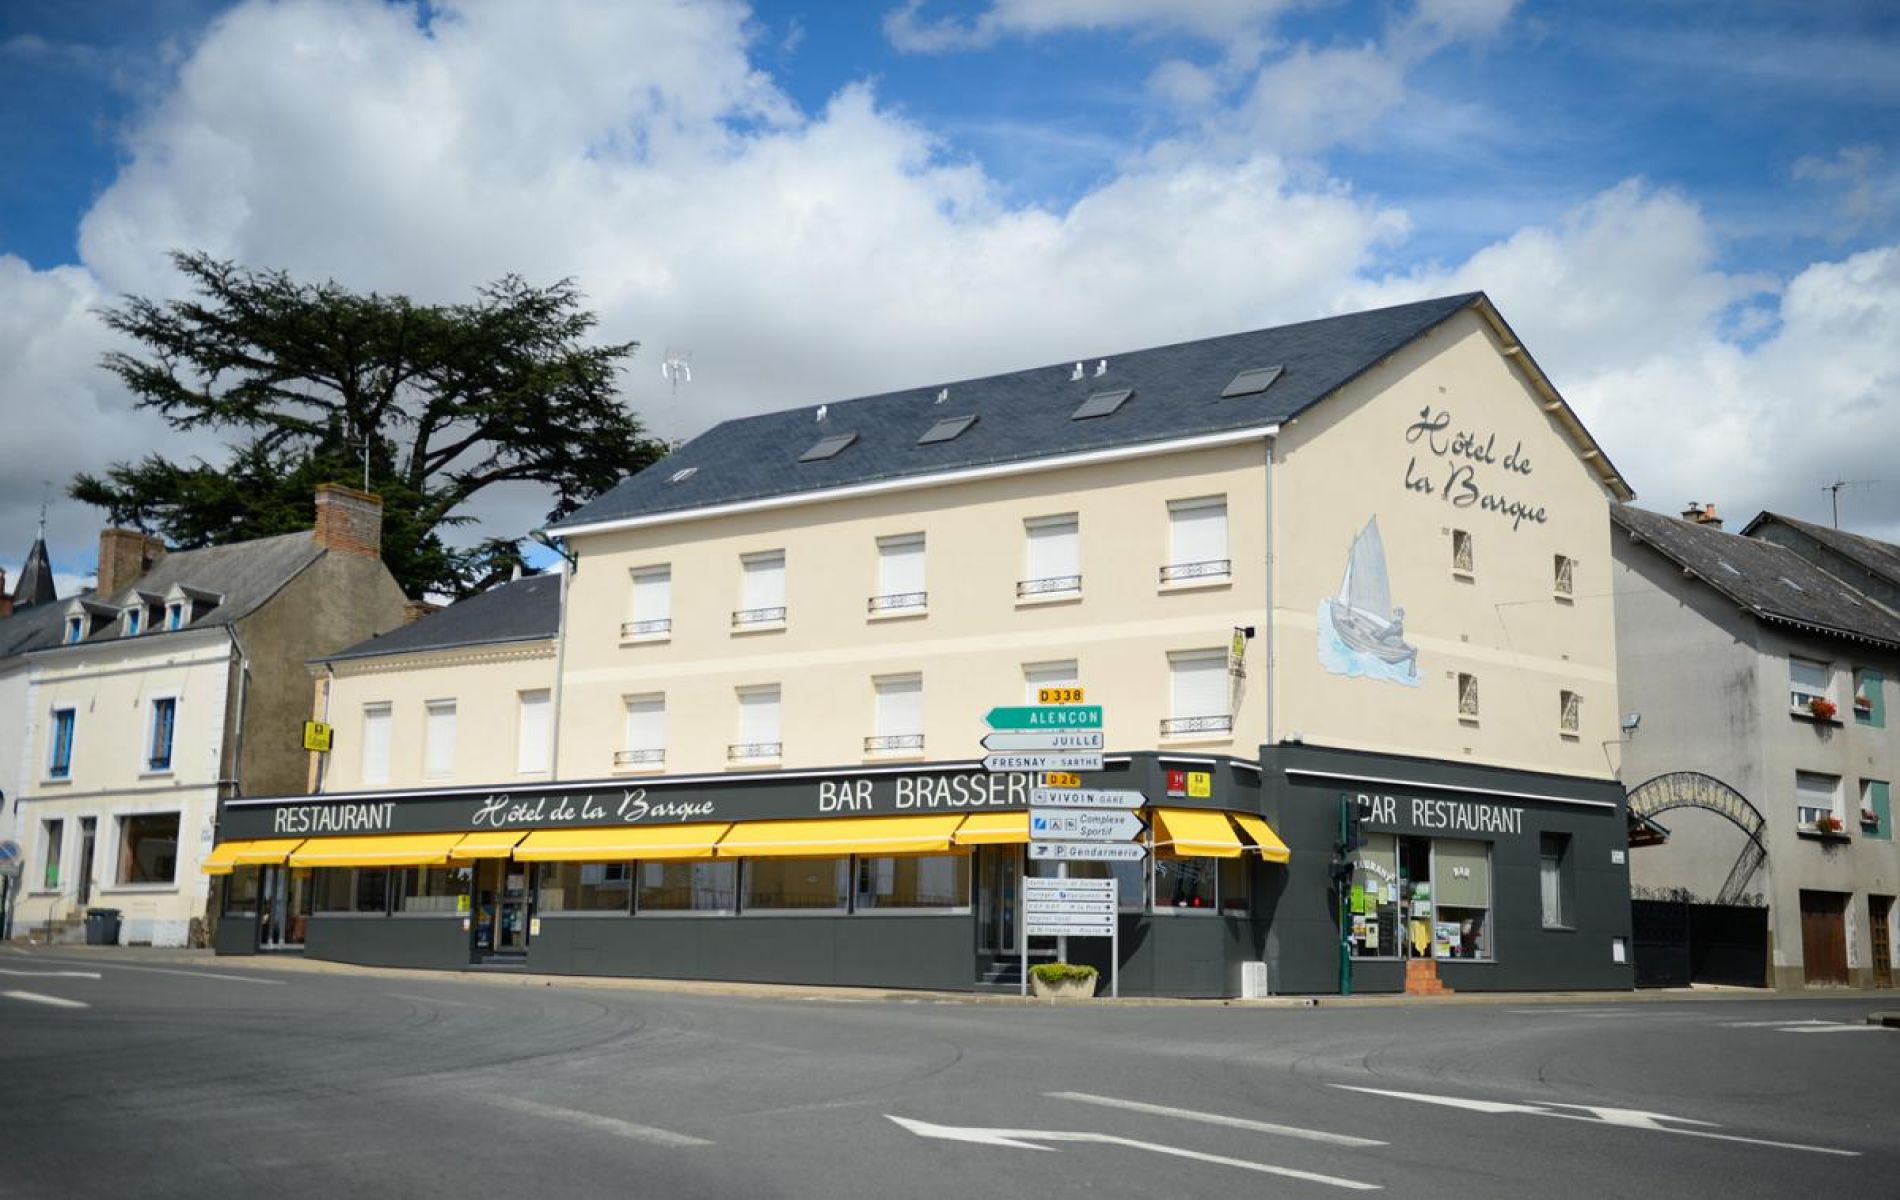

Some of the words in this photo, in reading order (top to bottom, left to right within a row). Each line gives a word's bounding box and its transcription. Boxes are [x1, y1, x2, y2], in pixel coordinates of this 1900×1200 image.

[1405, 405, 1496, 464] Hôtel
[1503, 441, 1532, 475] de
[1405, 456, 1435, 494] la
[1441, 460, 1548, 532] Barque
[1041, 690, 1049, 702] D
[1054, 690, 1081, 702] 338
[1030, 711, 1098, 725] ALENÇON
[1053, 735, 1099, 746] JUILLÉ
[992, 758, 1046, 767] FRESNAY
[1050, 775, 1057, 785] D
[1062, 775, 1077, 785] 26
[819, 779, 873, 812] BAR
[472, 793, 546, 827] Hôtel
[550, 797, 576, 822] de
[581, 795, 607, 820] la
[617, 787, 715, 822] Barque
[274, 802, 397, 833] RESTAURANT
[1080, 814, 1125, 826] Complexe
[1411, 799, 1524, 835] RESTAURANT
[1080, 826, 1113, 838] Sportif
[1069, 846, 1138, 857] Gendarmerie
